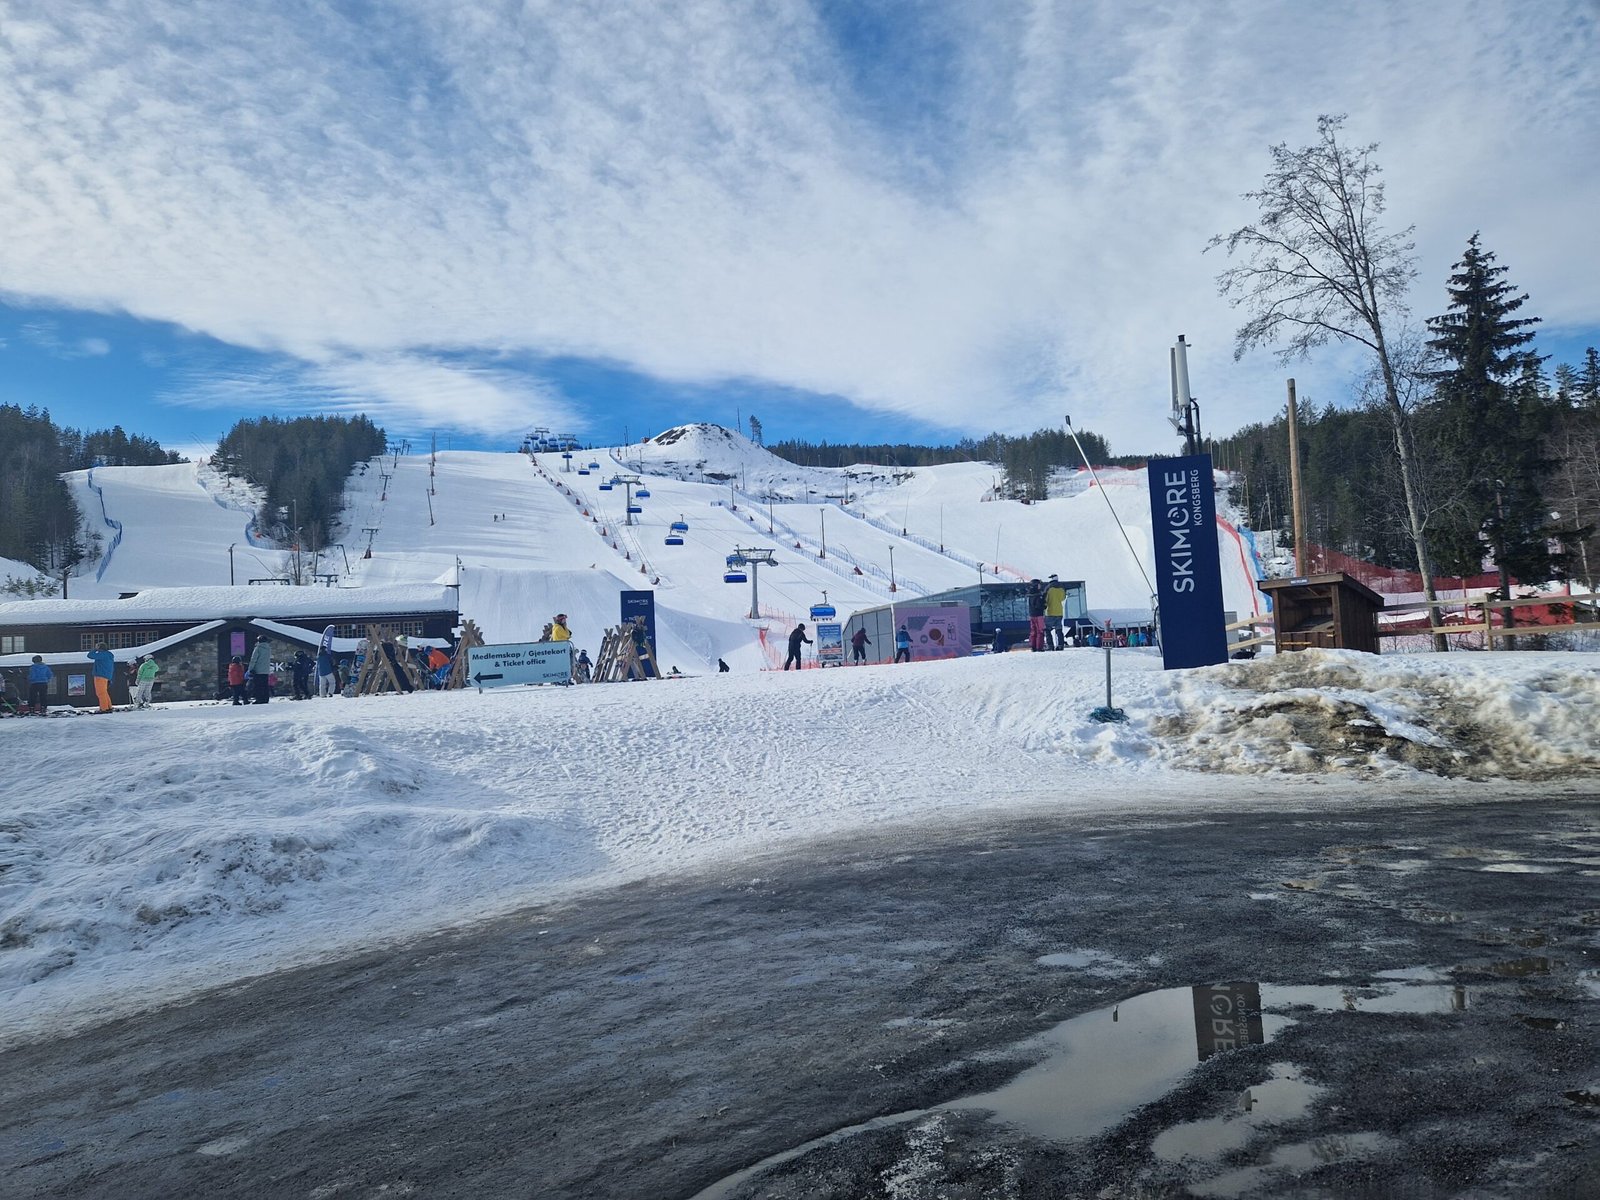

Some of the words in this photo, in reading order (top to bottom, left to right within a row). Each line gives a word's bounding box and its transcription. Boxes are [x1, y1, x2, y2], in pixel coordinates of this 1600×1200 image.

[1190, 469, 1202, 526] KONGSBERG
[1164, 470, 1195, 592] SKIMORE
[472, 651, 521, 660] Medlemskap
[528, 648, 566, 657] Gjestekort
[526, 658, 546, 666] office
